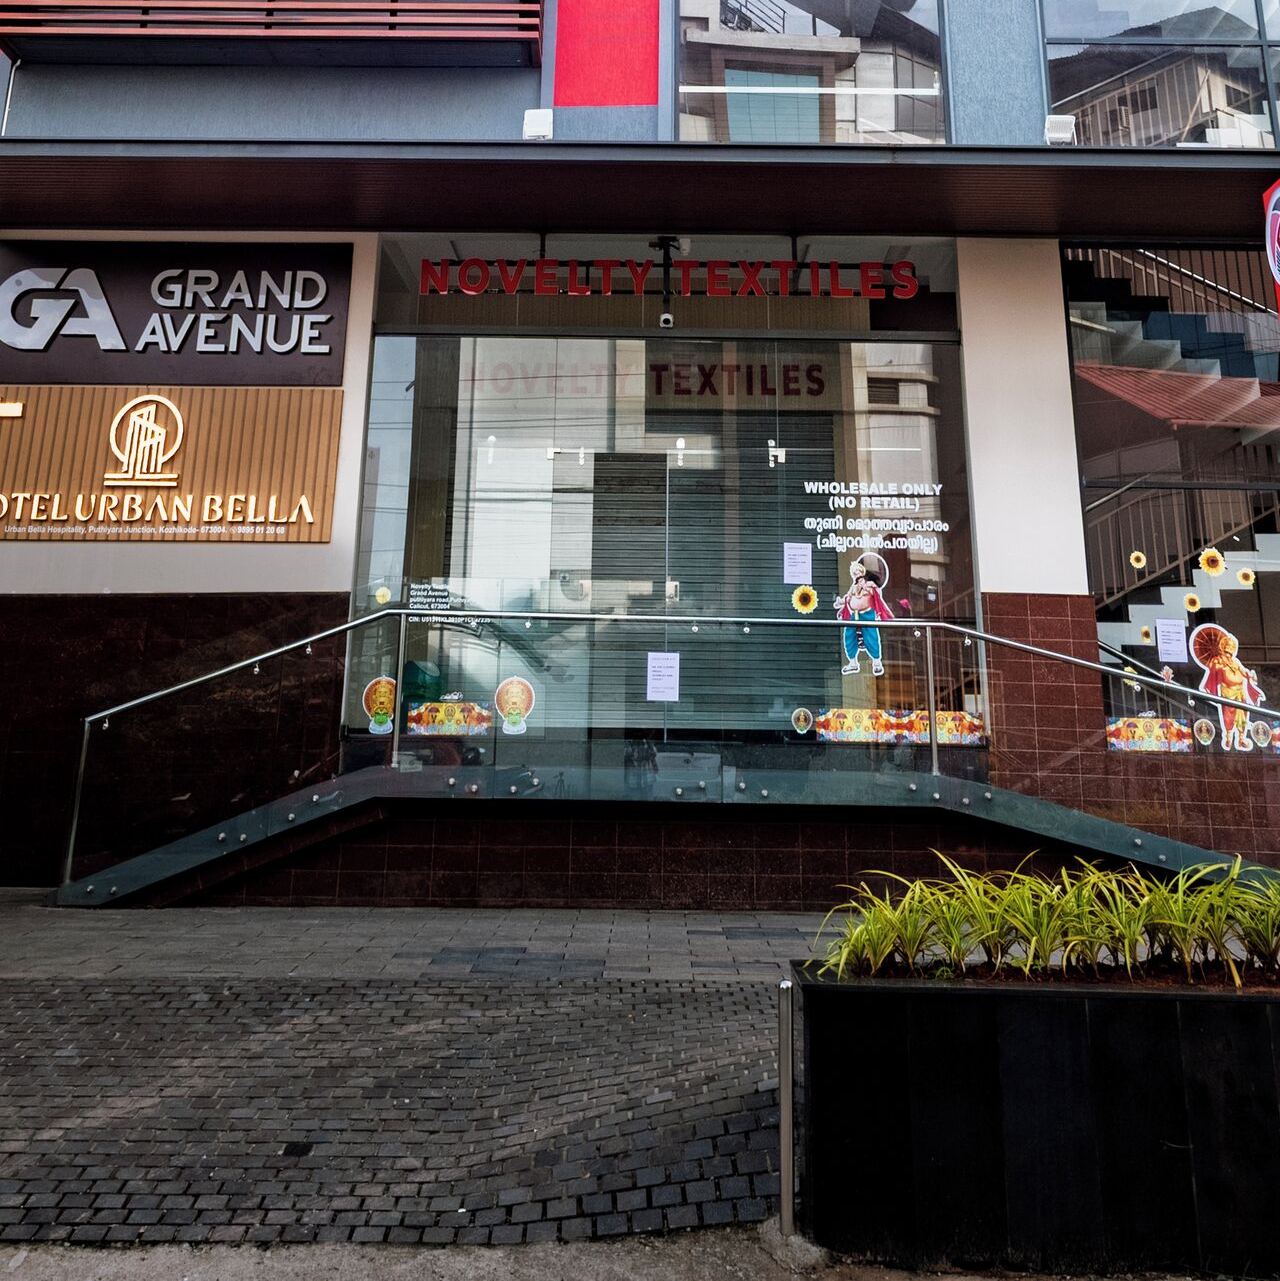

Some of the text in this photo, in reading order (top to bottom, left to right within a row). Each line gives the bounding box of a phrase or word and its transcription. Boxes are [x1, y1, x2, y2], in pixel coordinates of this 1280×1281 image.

[149, 268, 328, 310] GRAND
[420, 257, 919, 299] NOVELTY TEXTILES
[133, 312, 333, 355] AVENUE
[650, 363, 826, 398] TEXTILES
[803, 481, 943, 496] WHOLESALE ONLY
[828, 496, 919, 512] (NO RETAIL)
[76, 494, 194, 523] URBAN
[203, 495, 315, 525] BELLA
[803, 515, 843, 533] തുണി
[4, 525, 26, 533] Urban
[28, 525, 47, 533] Bella
[47, 525, 87, 535] Hospitality,
[88, 525, 122, 535] Puthiyara
